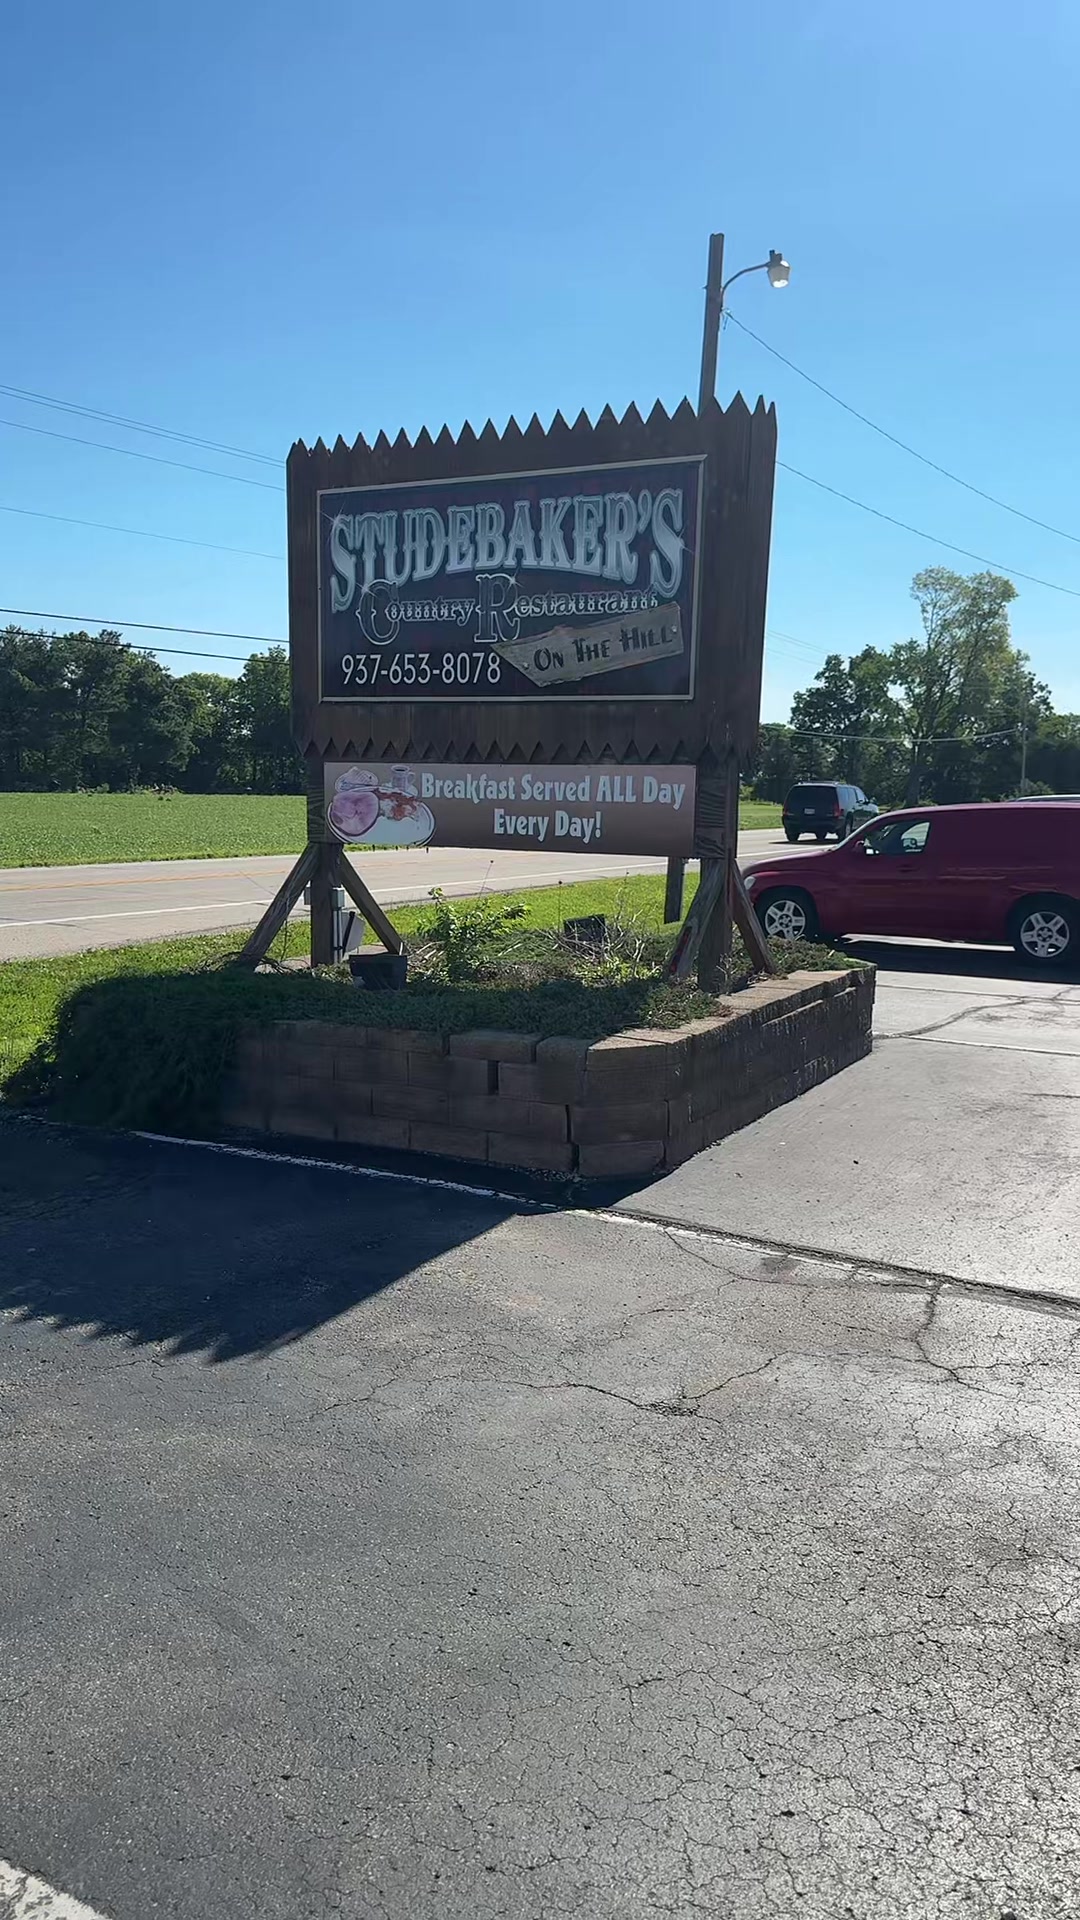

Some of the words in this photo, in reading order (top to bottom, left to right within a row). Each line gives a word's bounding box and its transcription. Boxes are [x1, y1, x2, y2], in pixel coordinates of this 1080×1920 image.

[330, 488, 684, 614] STUDEBAKER'S
[356, 578, 475, 645] Country
[474, 573, 659, 643] Restaurant
[341, 653, 501, 685] 937-653-8078
[420, 772, 516, 804] Breakfast
[520, 773, 591, 803] Served
[595, 775, 635, 803] ALL
[641, 775, 686, 811] Day
[493, 808, 549, 843] Every
[554, 810, 602, 844] Day!
